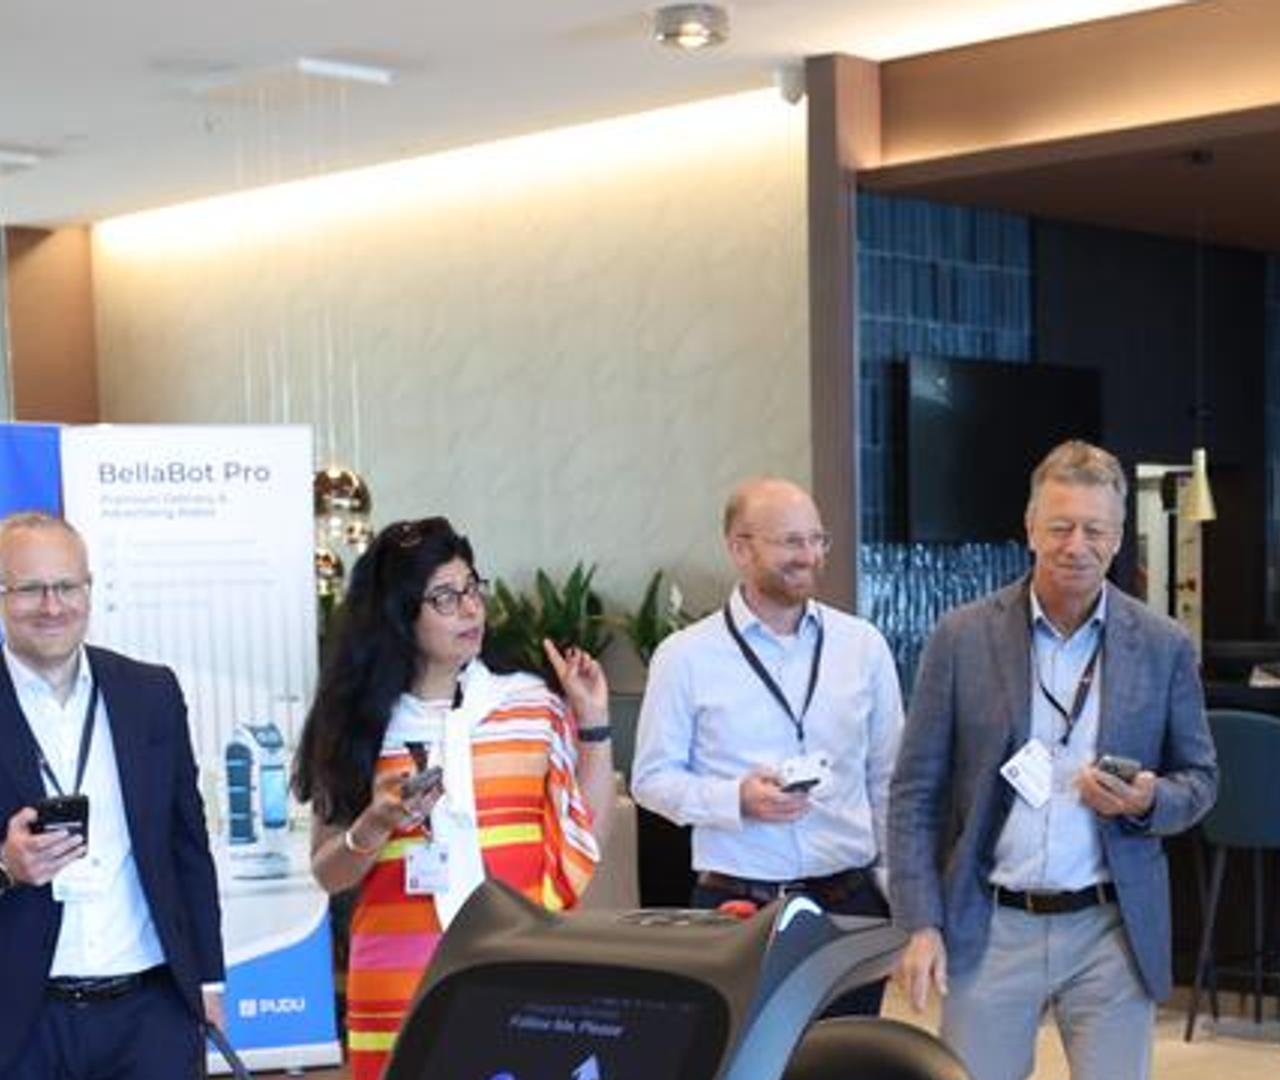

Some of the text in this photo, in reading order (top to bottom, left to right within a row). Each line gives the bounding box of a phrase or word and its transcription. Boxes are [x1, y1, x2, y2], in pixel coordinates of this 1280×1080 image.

[99, 461, 272, 484] BellaBot Pro
[259, 997, 306, 1014] PUDU
